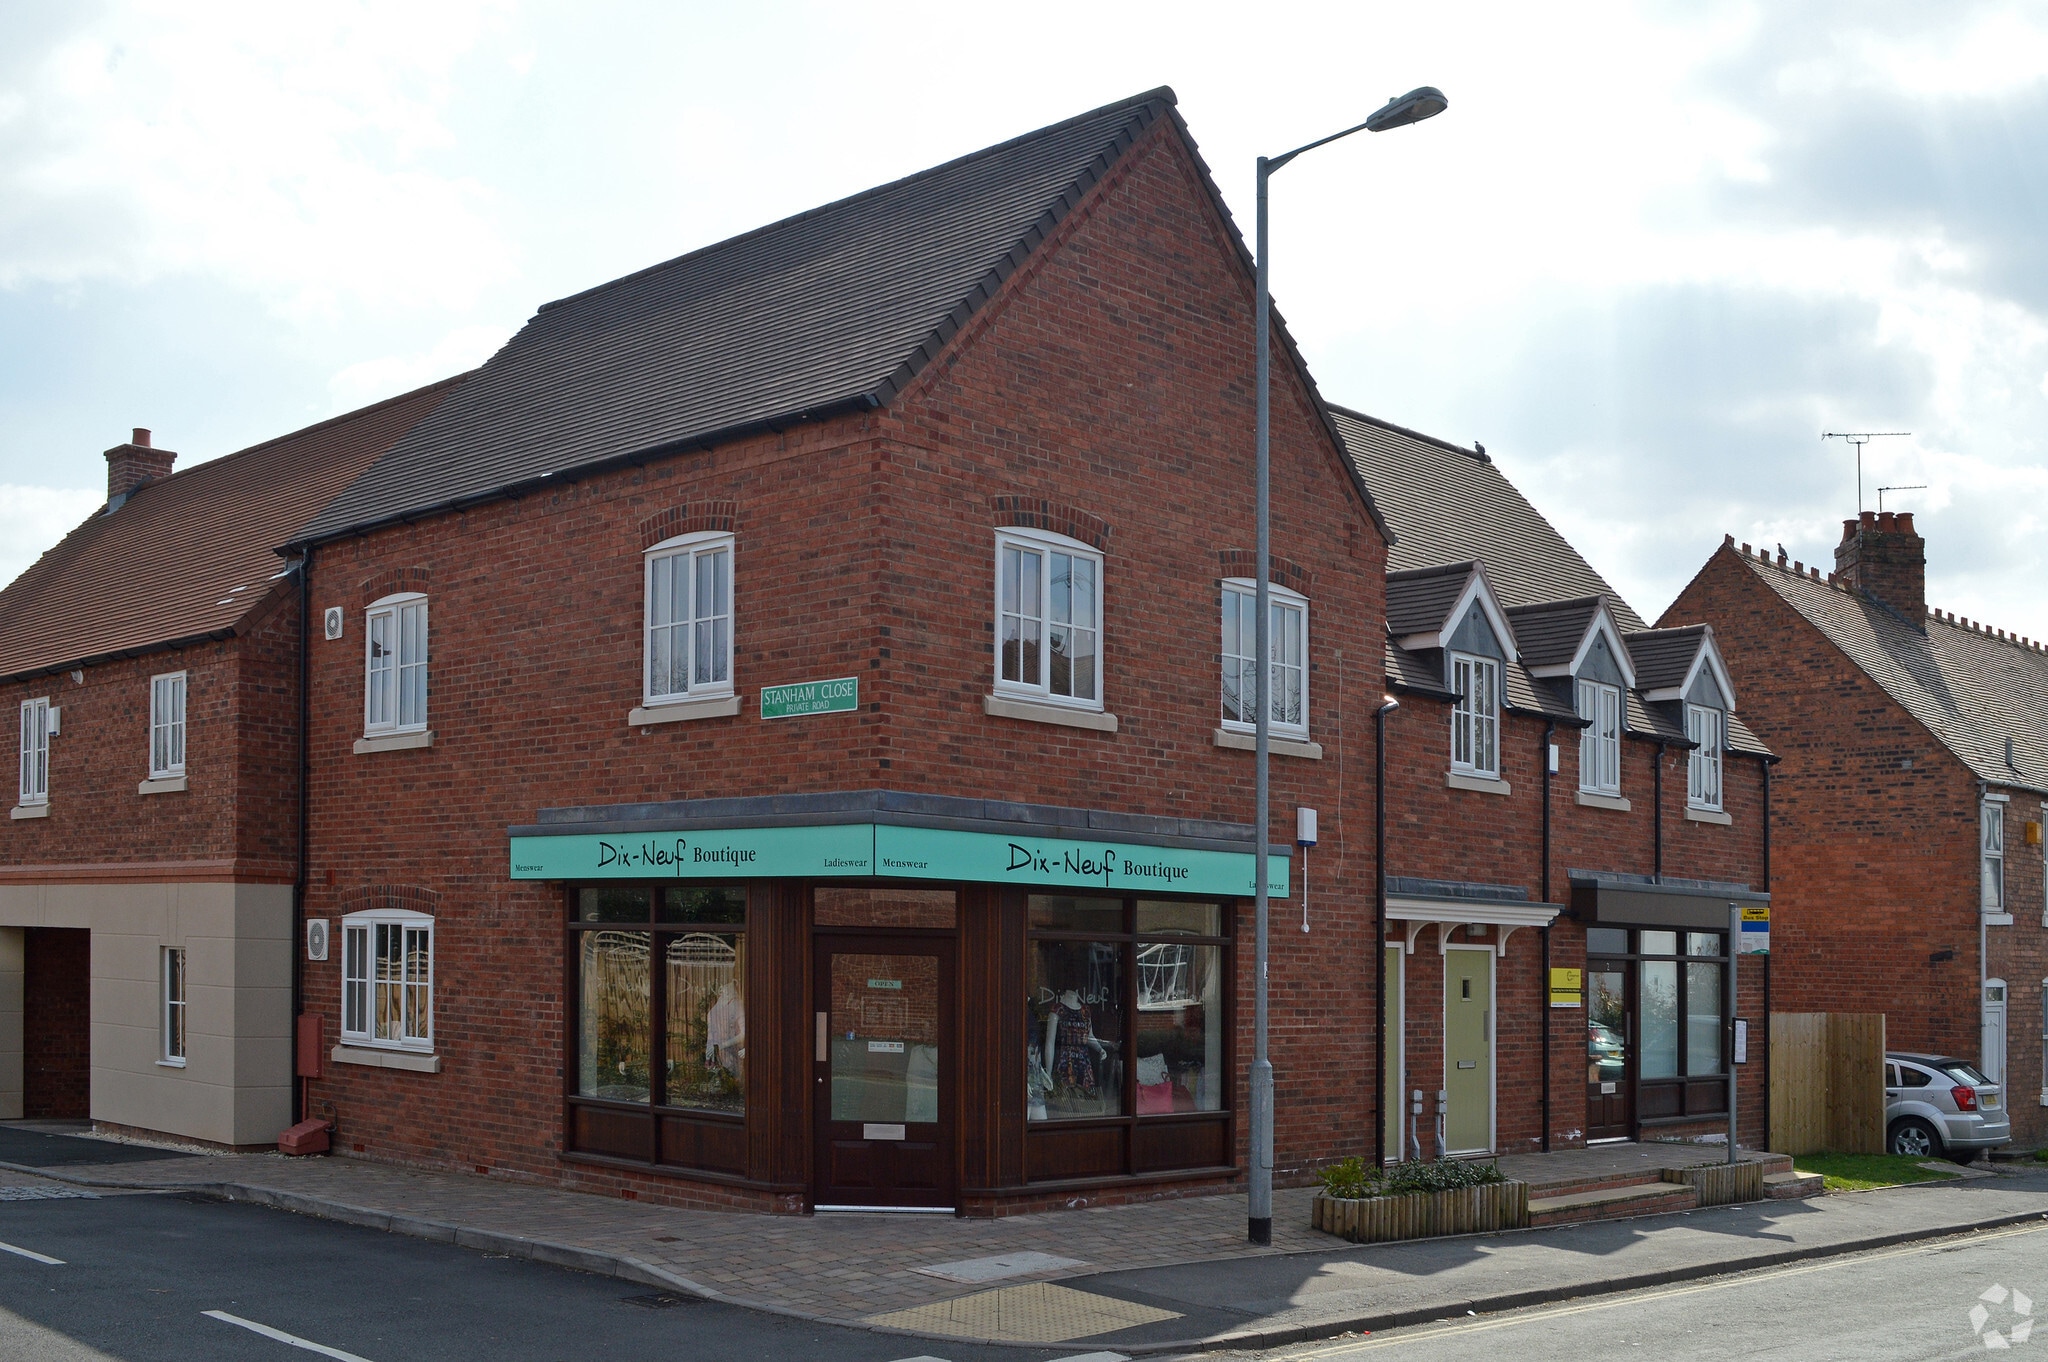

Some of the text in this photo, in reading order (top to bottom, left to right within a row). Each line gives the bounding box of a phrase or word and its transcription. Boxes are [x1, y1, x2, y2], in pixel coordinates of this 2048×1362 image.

[764, 682, 854, 705] STANHAM CLOSE
[786, 700, 830, 713] PRIVATE ROAD
[597, 838, 757, 877] Dix-Neuf Boutique
[823, 858, 868, 868] Ladieswear
[882, 858, 928, 869] Menswear
[515, 863, 544, 872] Menswear
[1006, 843, 1189, 887] Dix-Neuf Boutique
